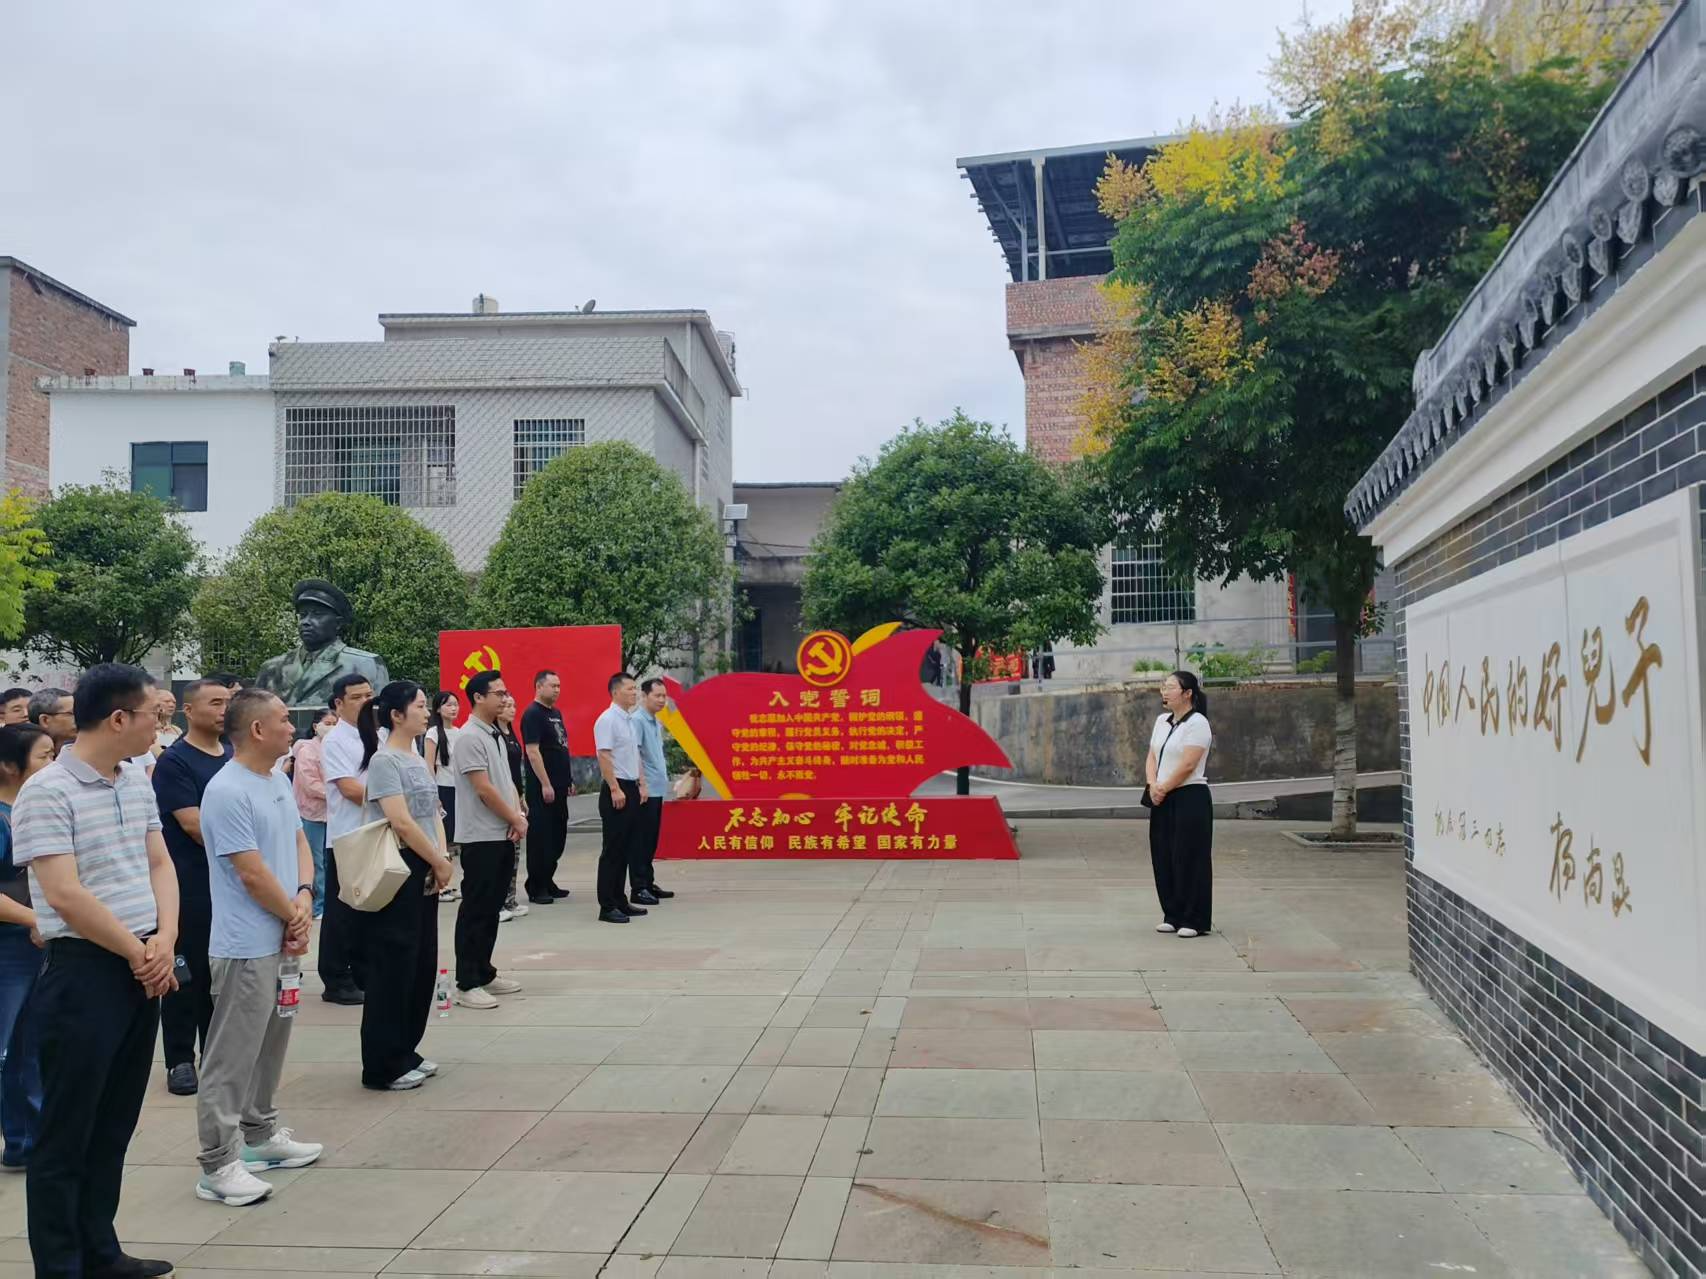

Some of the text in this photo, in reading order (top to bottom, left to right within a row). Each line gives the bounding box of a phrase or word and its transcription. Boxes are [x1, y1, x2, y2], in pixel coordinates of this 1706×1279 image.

[769, 689, 881, 708] 入党誓词
[724, 802, 928, 834] 不忘初心 牢记使命
[697, 835, 958, 850] 人民有信仰 民族有希望 国家有力量
